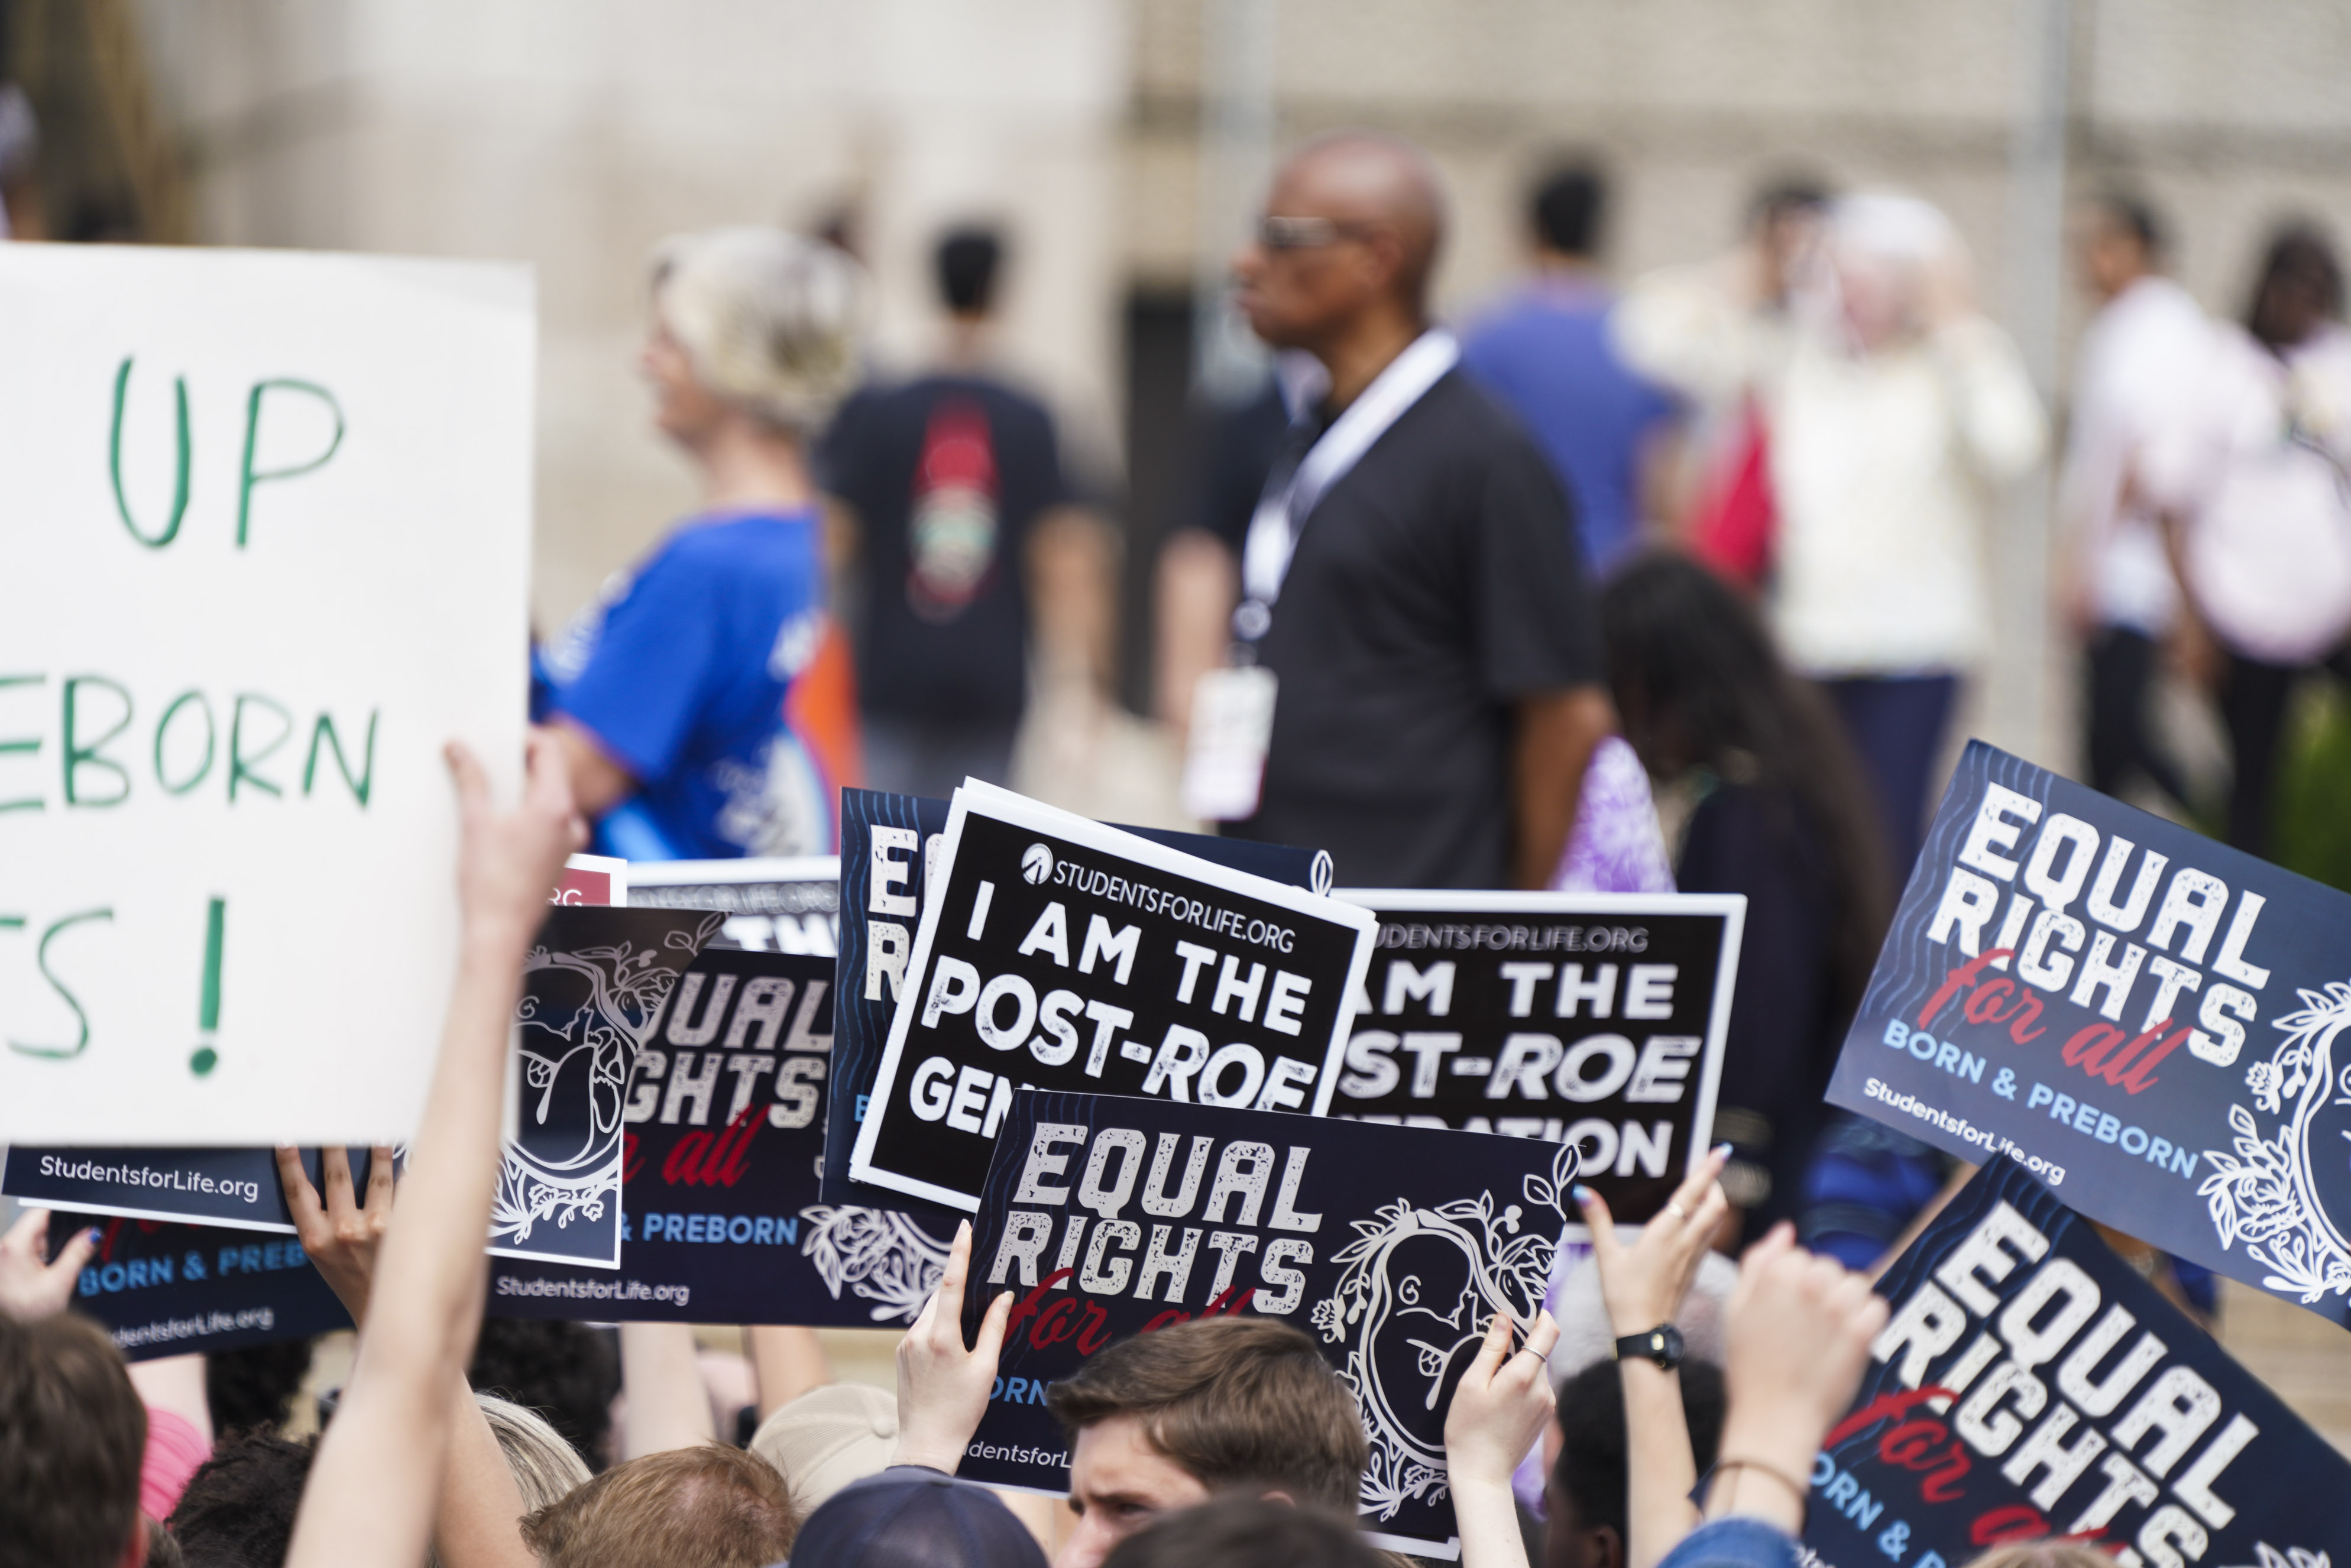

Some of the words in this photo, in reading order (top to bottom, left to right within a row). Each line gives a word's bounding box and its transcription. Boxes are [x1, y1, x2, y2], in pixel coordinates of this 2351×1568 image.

[109, 355, 344, 550] UP
[1054, 860, 1296, 953] STUDENTSFORLIFE.ORG
[1958, 781, 2271, 990] EQUAL
[643, 971, 834, 1052] UAL
[967, 880, 995, 940] I
[1018, 901, 1141, 986] AM
[1175, 939, 1313, 1036] THE
[1500, 961, 1679, 1019] THE
[1926, 866, 2258, 1068] RIGHTS
[921, 955, 1318, 1112] POST-ROE
[1338, 1030, 1703, 1103] ST-ROE
[1918, 947, 2047, 1045] for
[2061, 1017, 2194, 1095] all
[661, 1102, 774, 1188] all
[1863, 1076, 2067, 1187] StudentsforLife.org
[1883, 1018, 1987, 1084] BORN
[1991, 1066, 2018, 1100] &
[2028, 1081, 2200, 1180] PREBORN
[40, 1155, 258, 1204] StudentsforLife.org
[642, 1212, 799, 1245] PREBORN
[1013, 1122, 1324, 1233] EQUAL
[78, 1254, 174, 1298] BORN
[182, 1248, 208, 1281] &
[496, 1275, 691, 1307] StudentsforLife.org
[987, 1209, 1314, 1316] RIGHTS
[1000, 1266, 1112, 1357] for
[1935, 1198, 2259, 1531] EQUAL
[1822, 1384, 1972, 1504] for
[1870, 1279, 2209, 1568] RIGHTS
[1877, 1518, 1911, 1564] &
